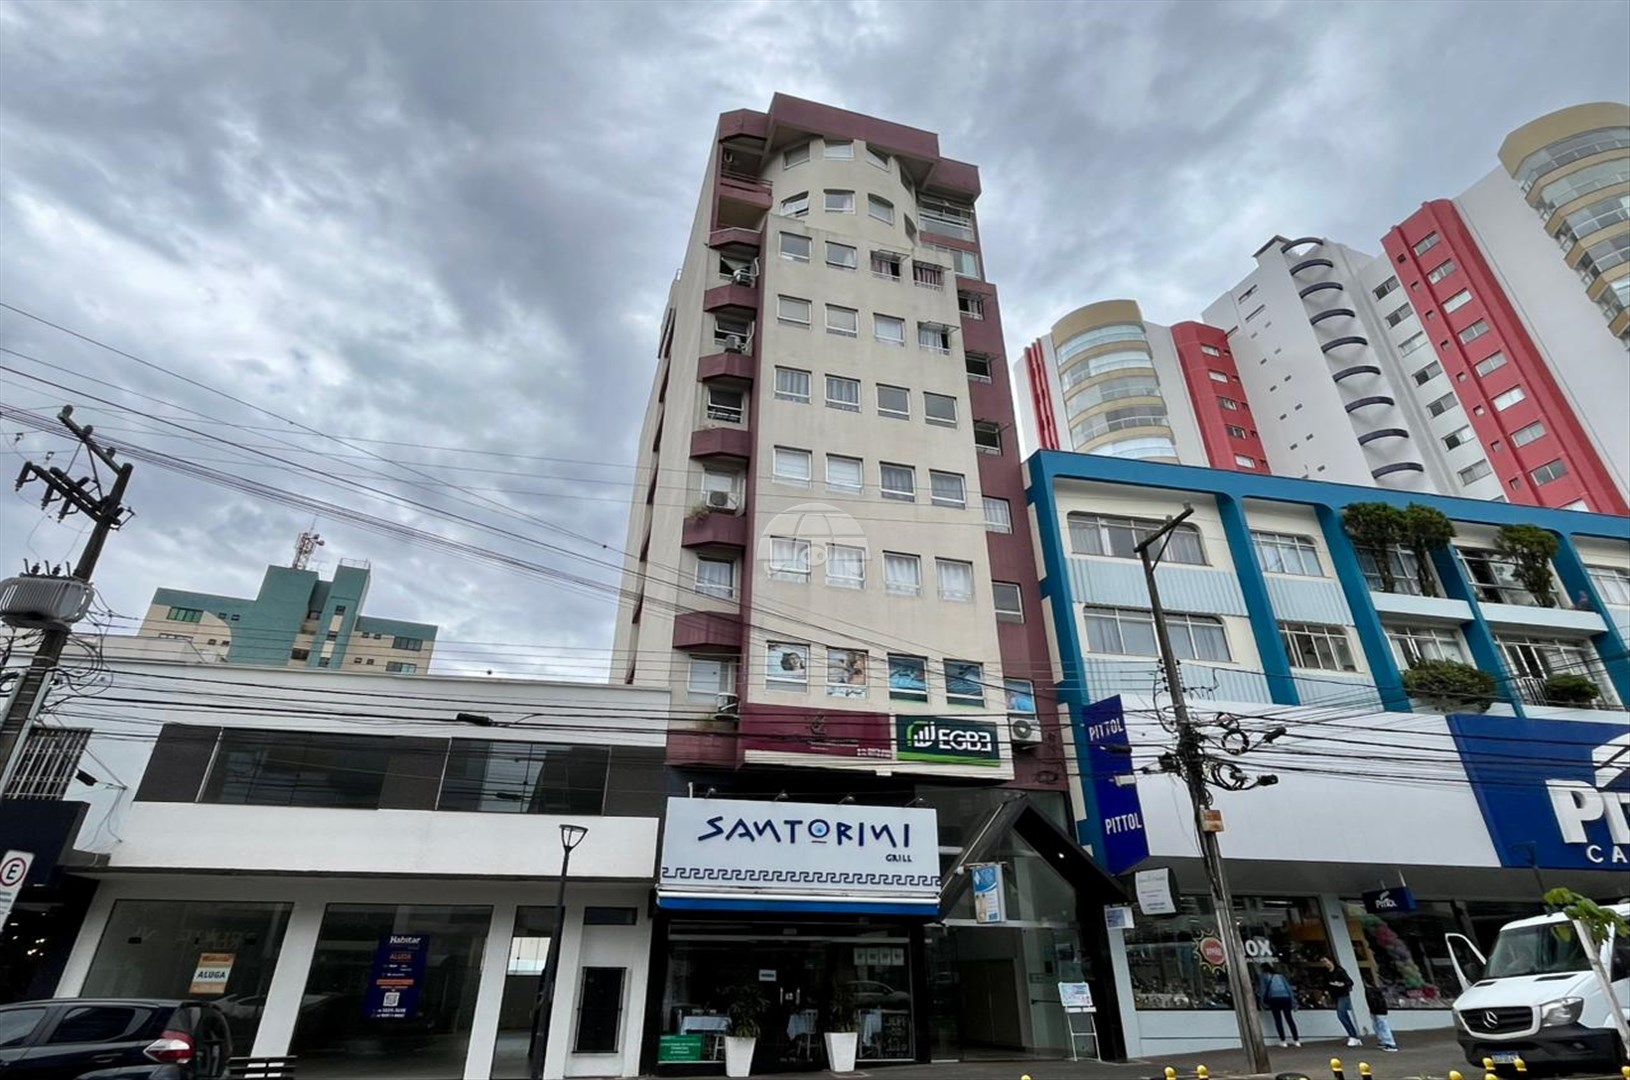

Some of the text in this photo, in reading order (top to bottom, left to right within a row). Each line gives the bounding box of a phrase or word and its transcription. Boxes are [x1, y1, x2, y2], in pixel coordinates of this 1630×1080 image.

[1088, 718, 1124, 741] PITTOL
[1545, 778, 1630, 845] PI
[698, 816, 910, 848] SANTORINI
[1105, 812, 1142, 835] PITTOL
[885, 853, 912, 863] GRILL
[1586, 844, 1628, 864] CA
[6, 863, 20, 880] E
[389, 935, 421, 945] Habitar
[197, 971, 226, 979] ALUGA
